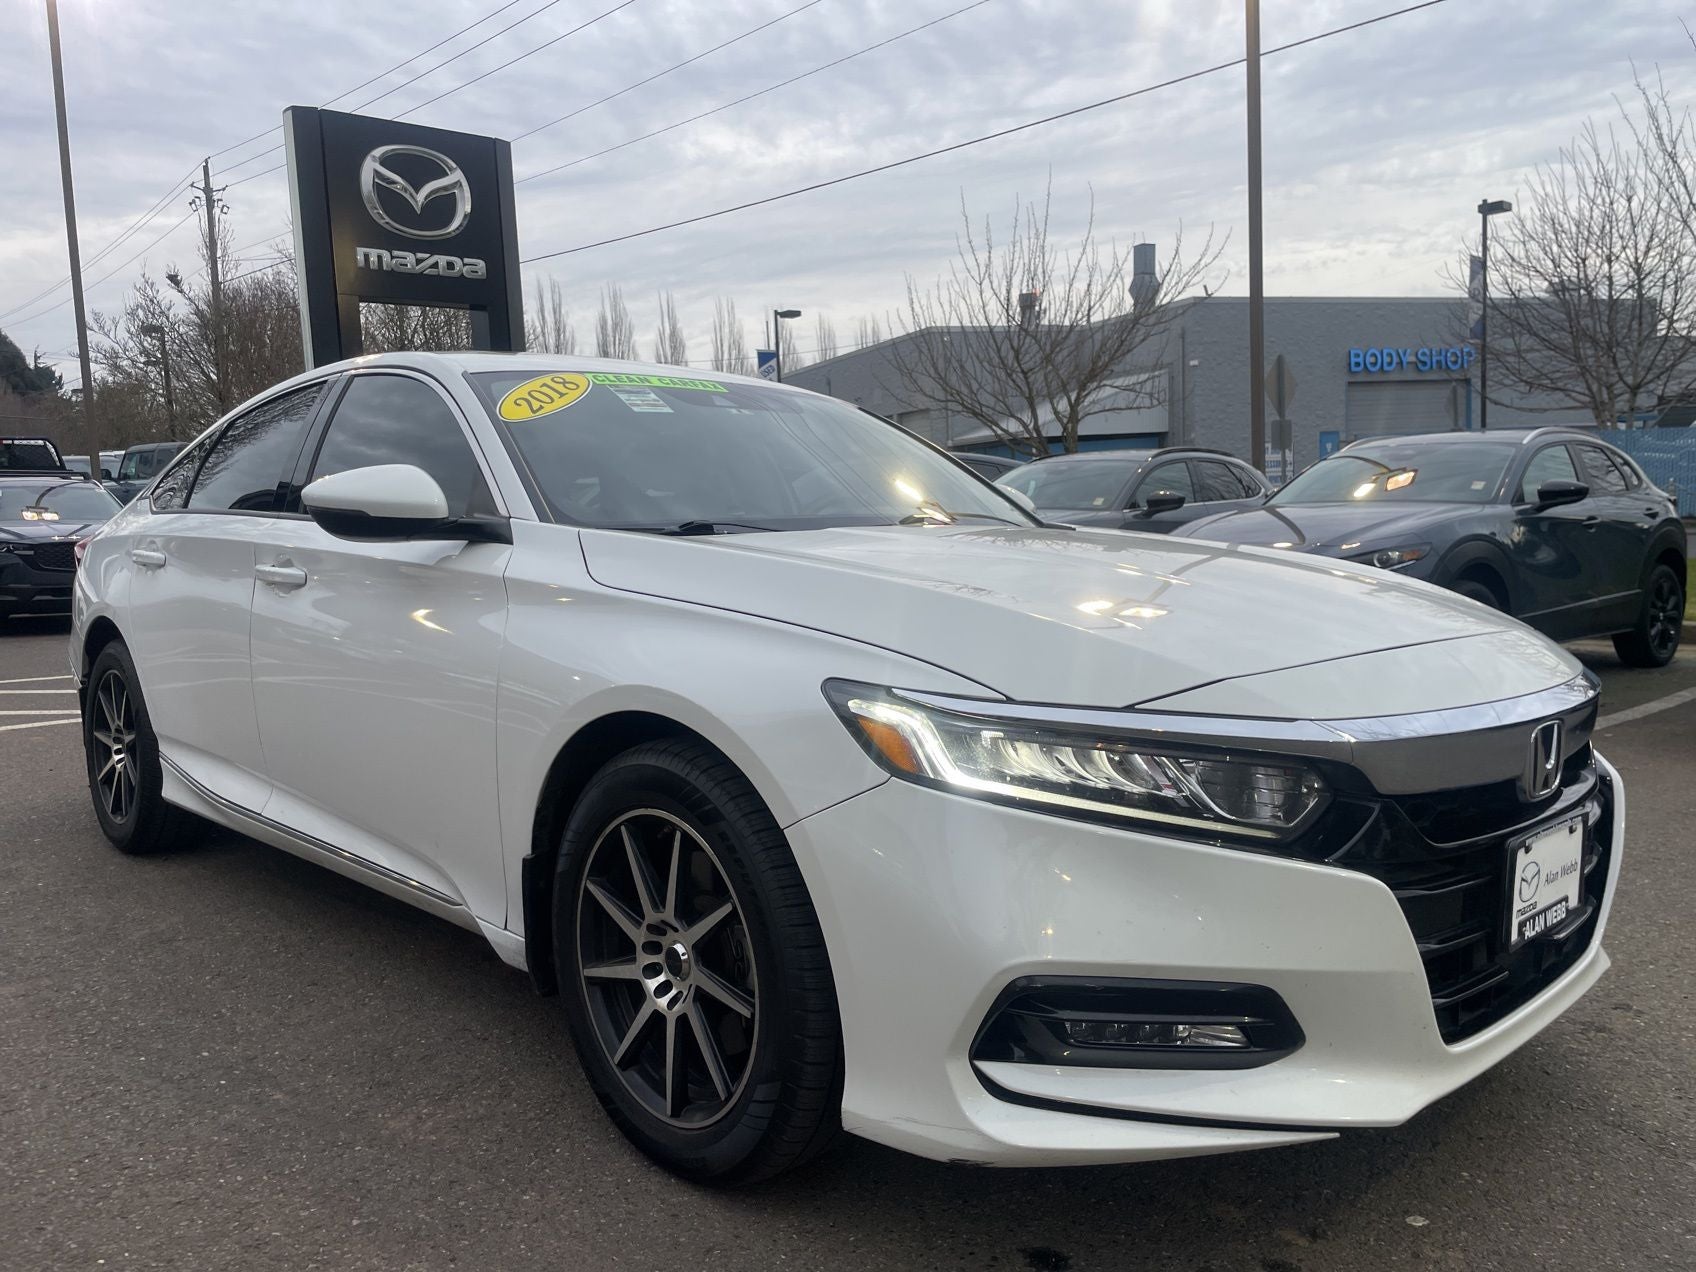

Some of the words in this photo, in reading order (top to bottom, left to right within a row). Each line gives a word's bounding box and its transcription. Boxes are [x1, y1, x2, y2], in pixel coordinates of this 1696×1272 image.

[356, 246, 487, 279] mazda
[1349, 347, 1411, 372] BODY
[1416, 345, 1475, 371] SHOP
[514, 375, 580, 415] 2018
[592, 374, 650, 385] CLEAN
[658, 377, 725, 390] CARFAX
[1544, 870, 1559, 886] Alan
[1560, 858, 1578, 877] Webb
[1524, 911, 1545, 940] ALAN
[1545, 901, 1567, 927] WEBB
